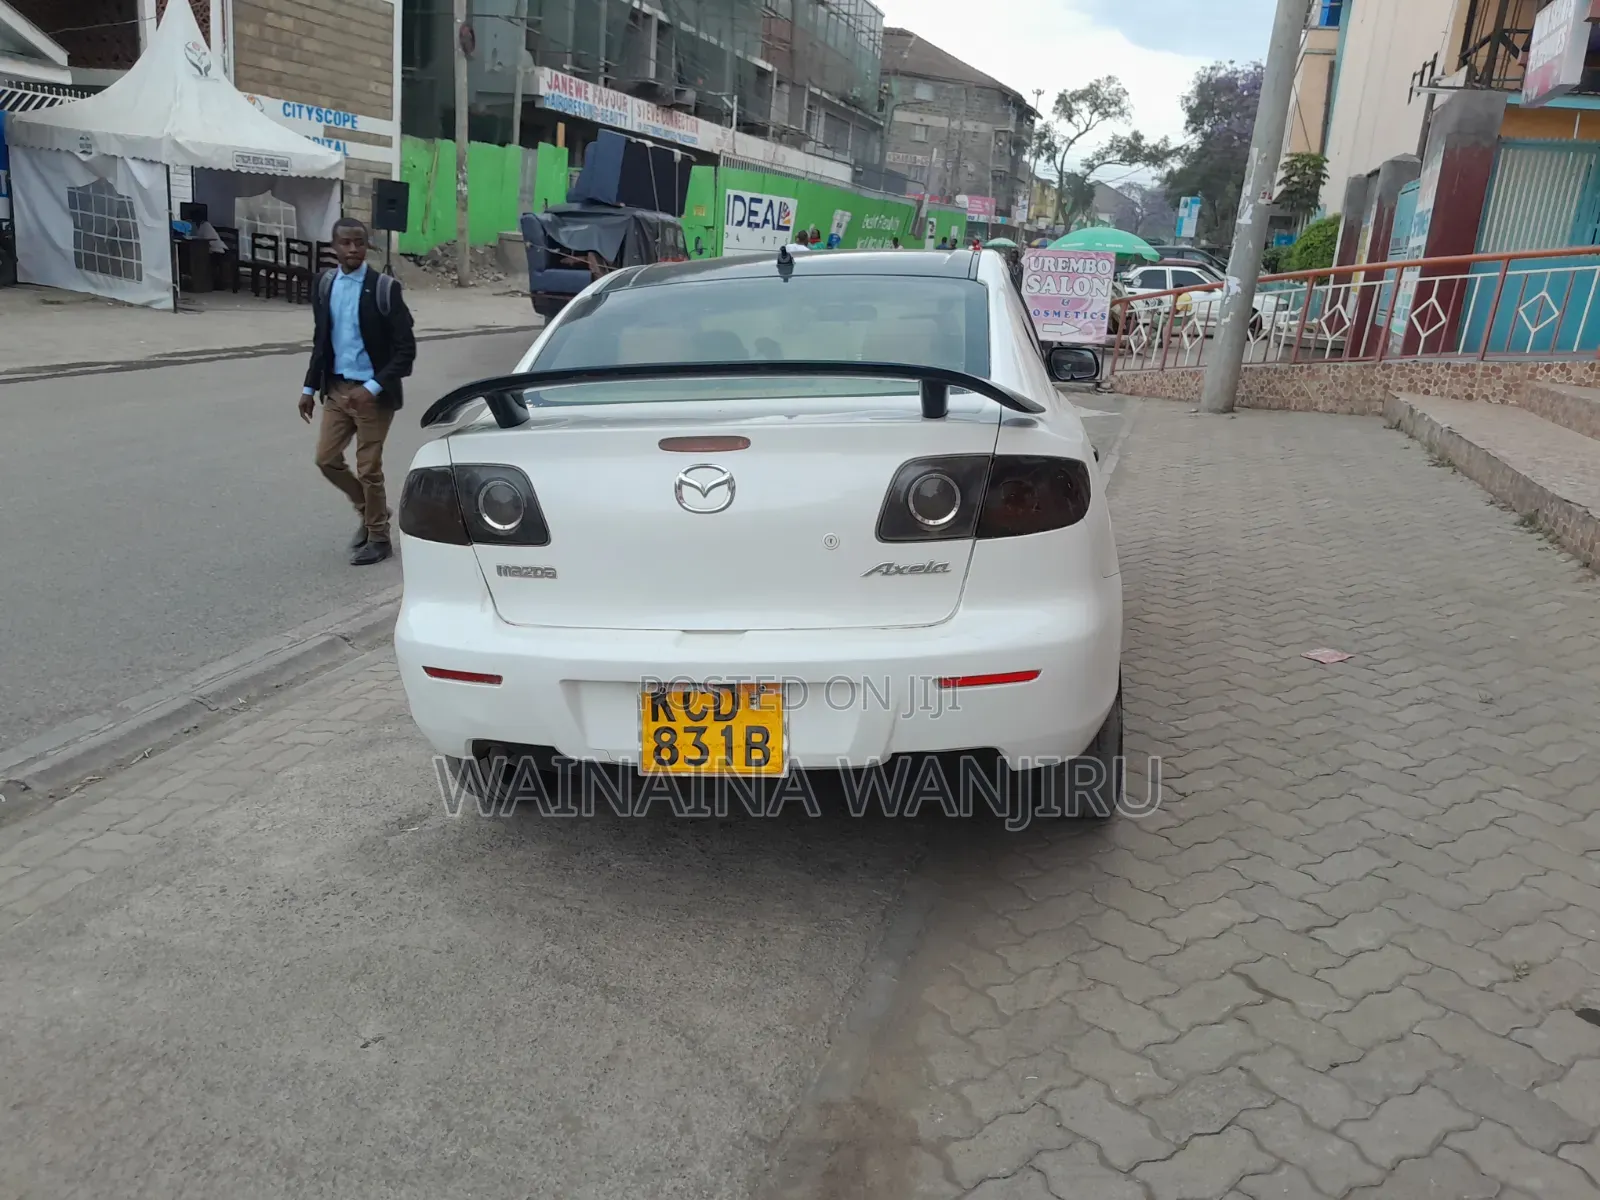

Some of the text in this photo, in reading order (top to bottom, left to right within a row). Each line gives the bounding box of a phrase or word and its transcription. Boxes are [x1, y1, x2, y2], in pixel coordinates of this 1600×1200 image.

[547, 71, 629, 114] JANEWE FAVOUR
[282, 101, 358, 129] CITYSCOPE
[726, 194, 791, 232] IDEAL
[1028, 256, 1111, 275] UREMBO
[1026, 273, 1111, 297] SALON
[1032, 308, 1107, 320] OSMETICS
[860, 559, 952, 577] Axela
[651, 684, 740, 722] KCD
[653, 725, 771, 767] 831B
